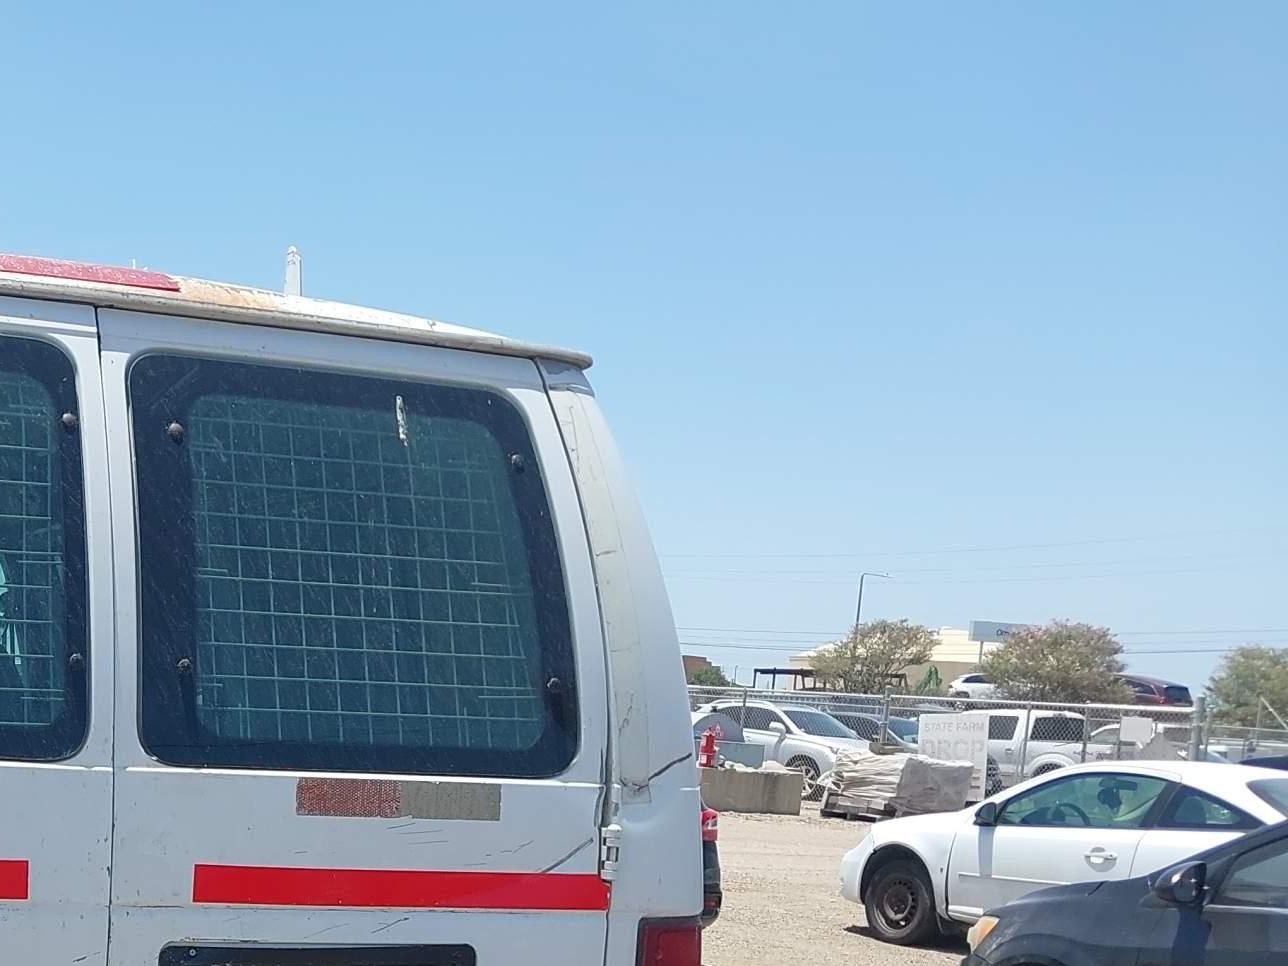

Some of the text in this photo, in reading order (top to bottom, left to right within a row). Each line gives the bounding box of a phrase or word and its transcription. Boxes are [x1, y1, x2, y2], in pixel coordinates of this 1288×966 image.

[924, 721, 984, 733] STATE FARM
[920, 738, 985, 760] DROP
